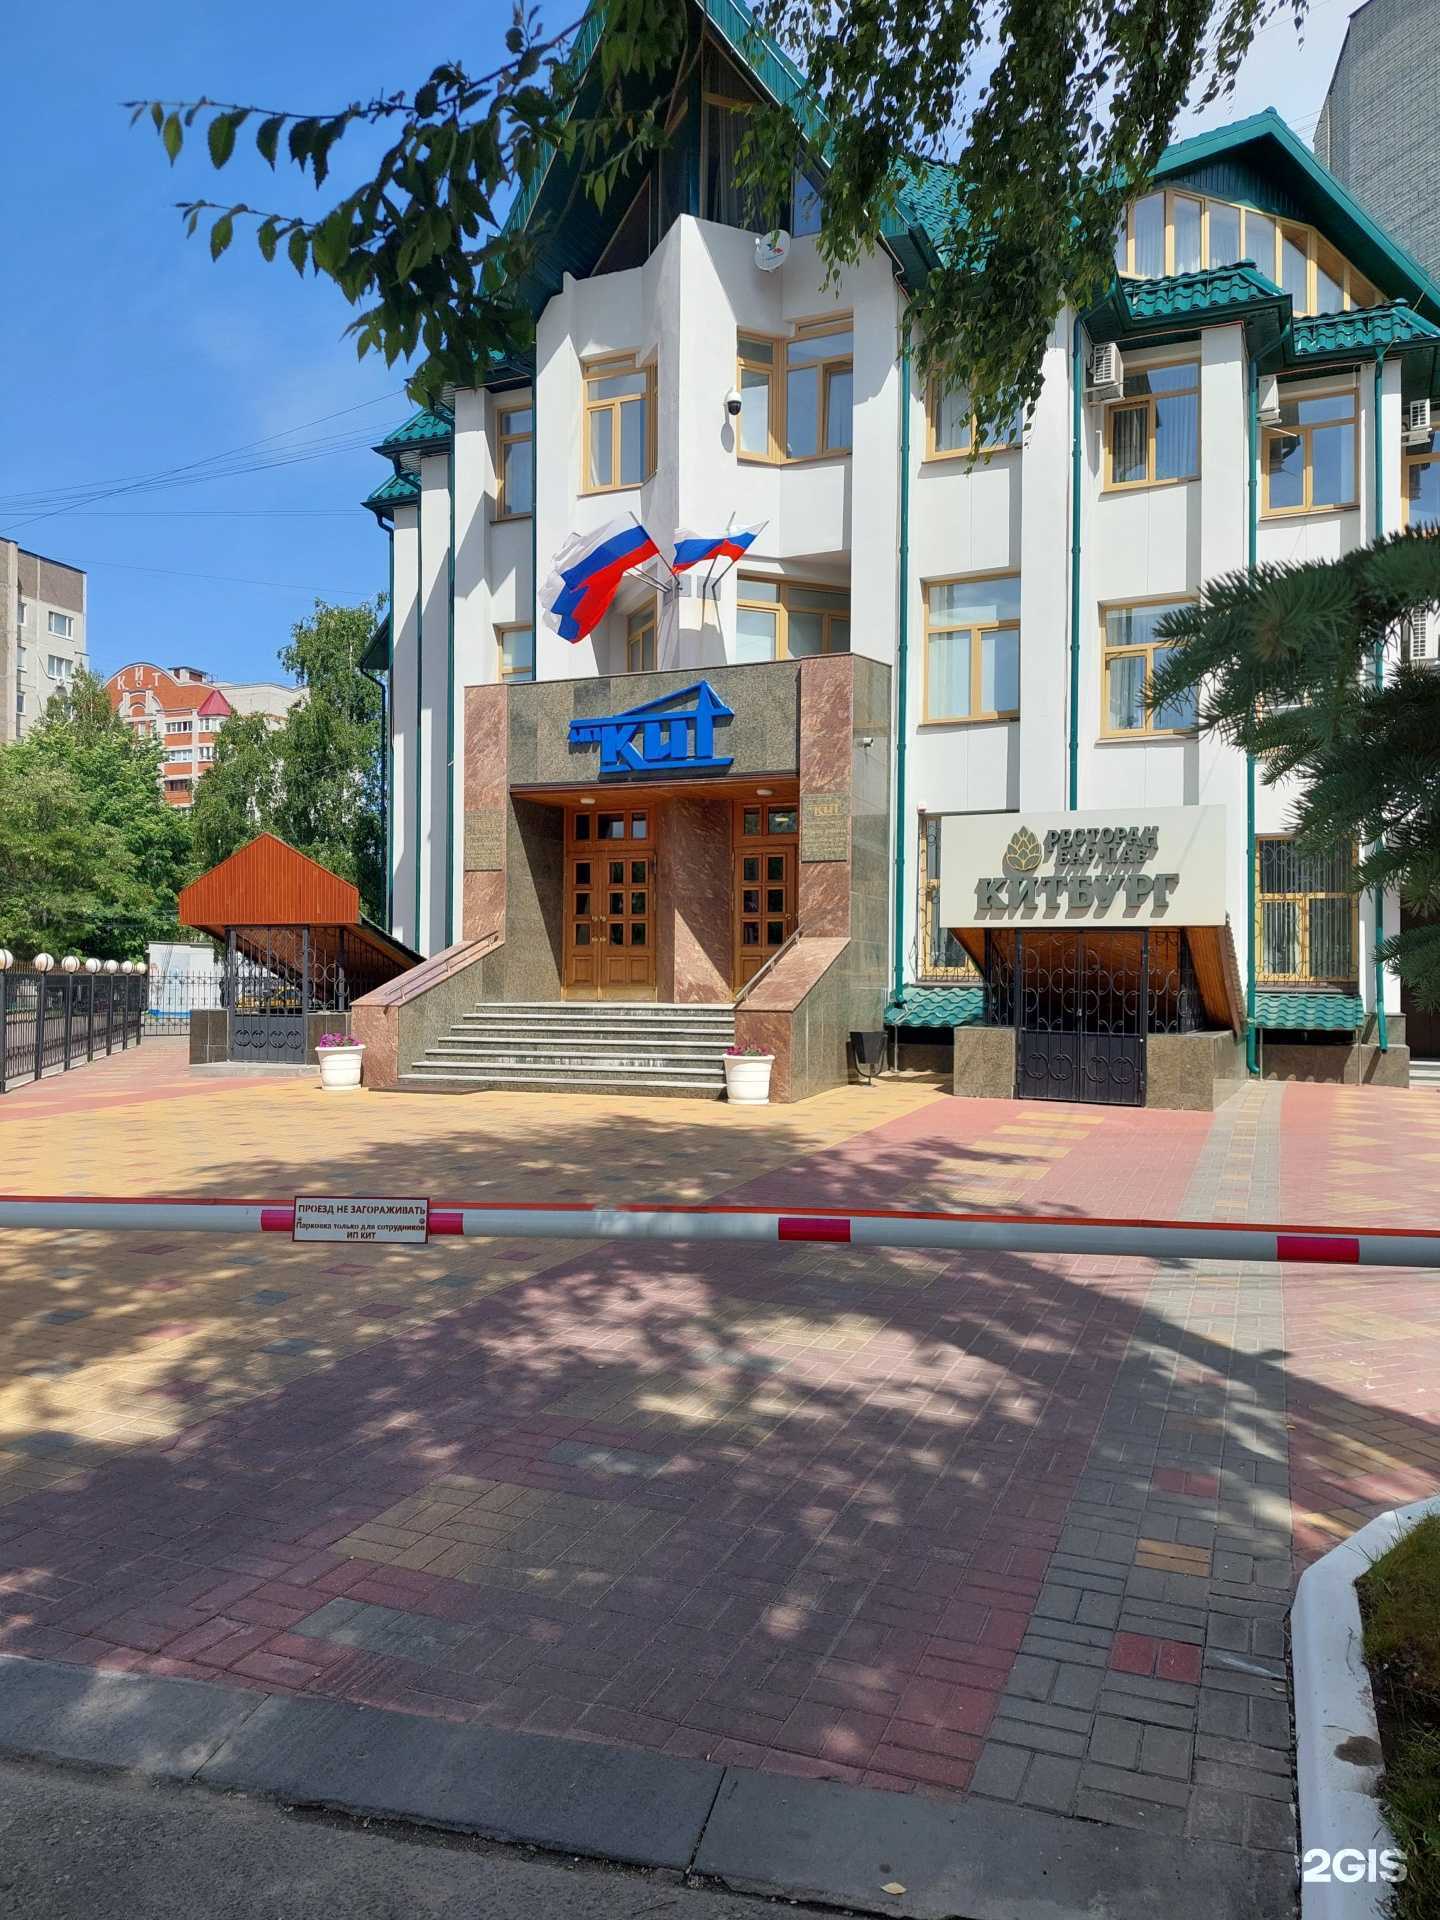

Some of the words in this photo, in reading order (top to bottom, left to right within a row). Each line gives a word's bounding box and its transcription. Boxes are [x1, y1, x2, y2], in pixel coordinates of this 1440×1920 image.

[117, 666, 161, 690] КИТ
[599, 680, 735, 773] КИТ
[1046, 825, 1160, 852] РЕСТОРАН
[1056, 846, 1149, 866] БАР-ПАБ
[976, 873, 1180, 911] КИТБУРГ
[298, 1204, 334, 1215] ПРОЕЗД
[337, 1204, 349, 1214] НЕ
[350, 1205, 426, 1215] ЗАГОРАЖИВАТЬ
[296, 1221, 332, 1231] Парковка
[360, 1224, 376, 1232] для
[377, 1223, 425, 1233] сотрудников
[346, 1231, 359, 1240] ИП
[360, 1231, 377, 1240] КИТ
